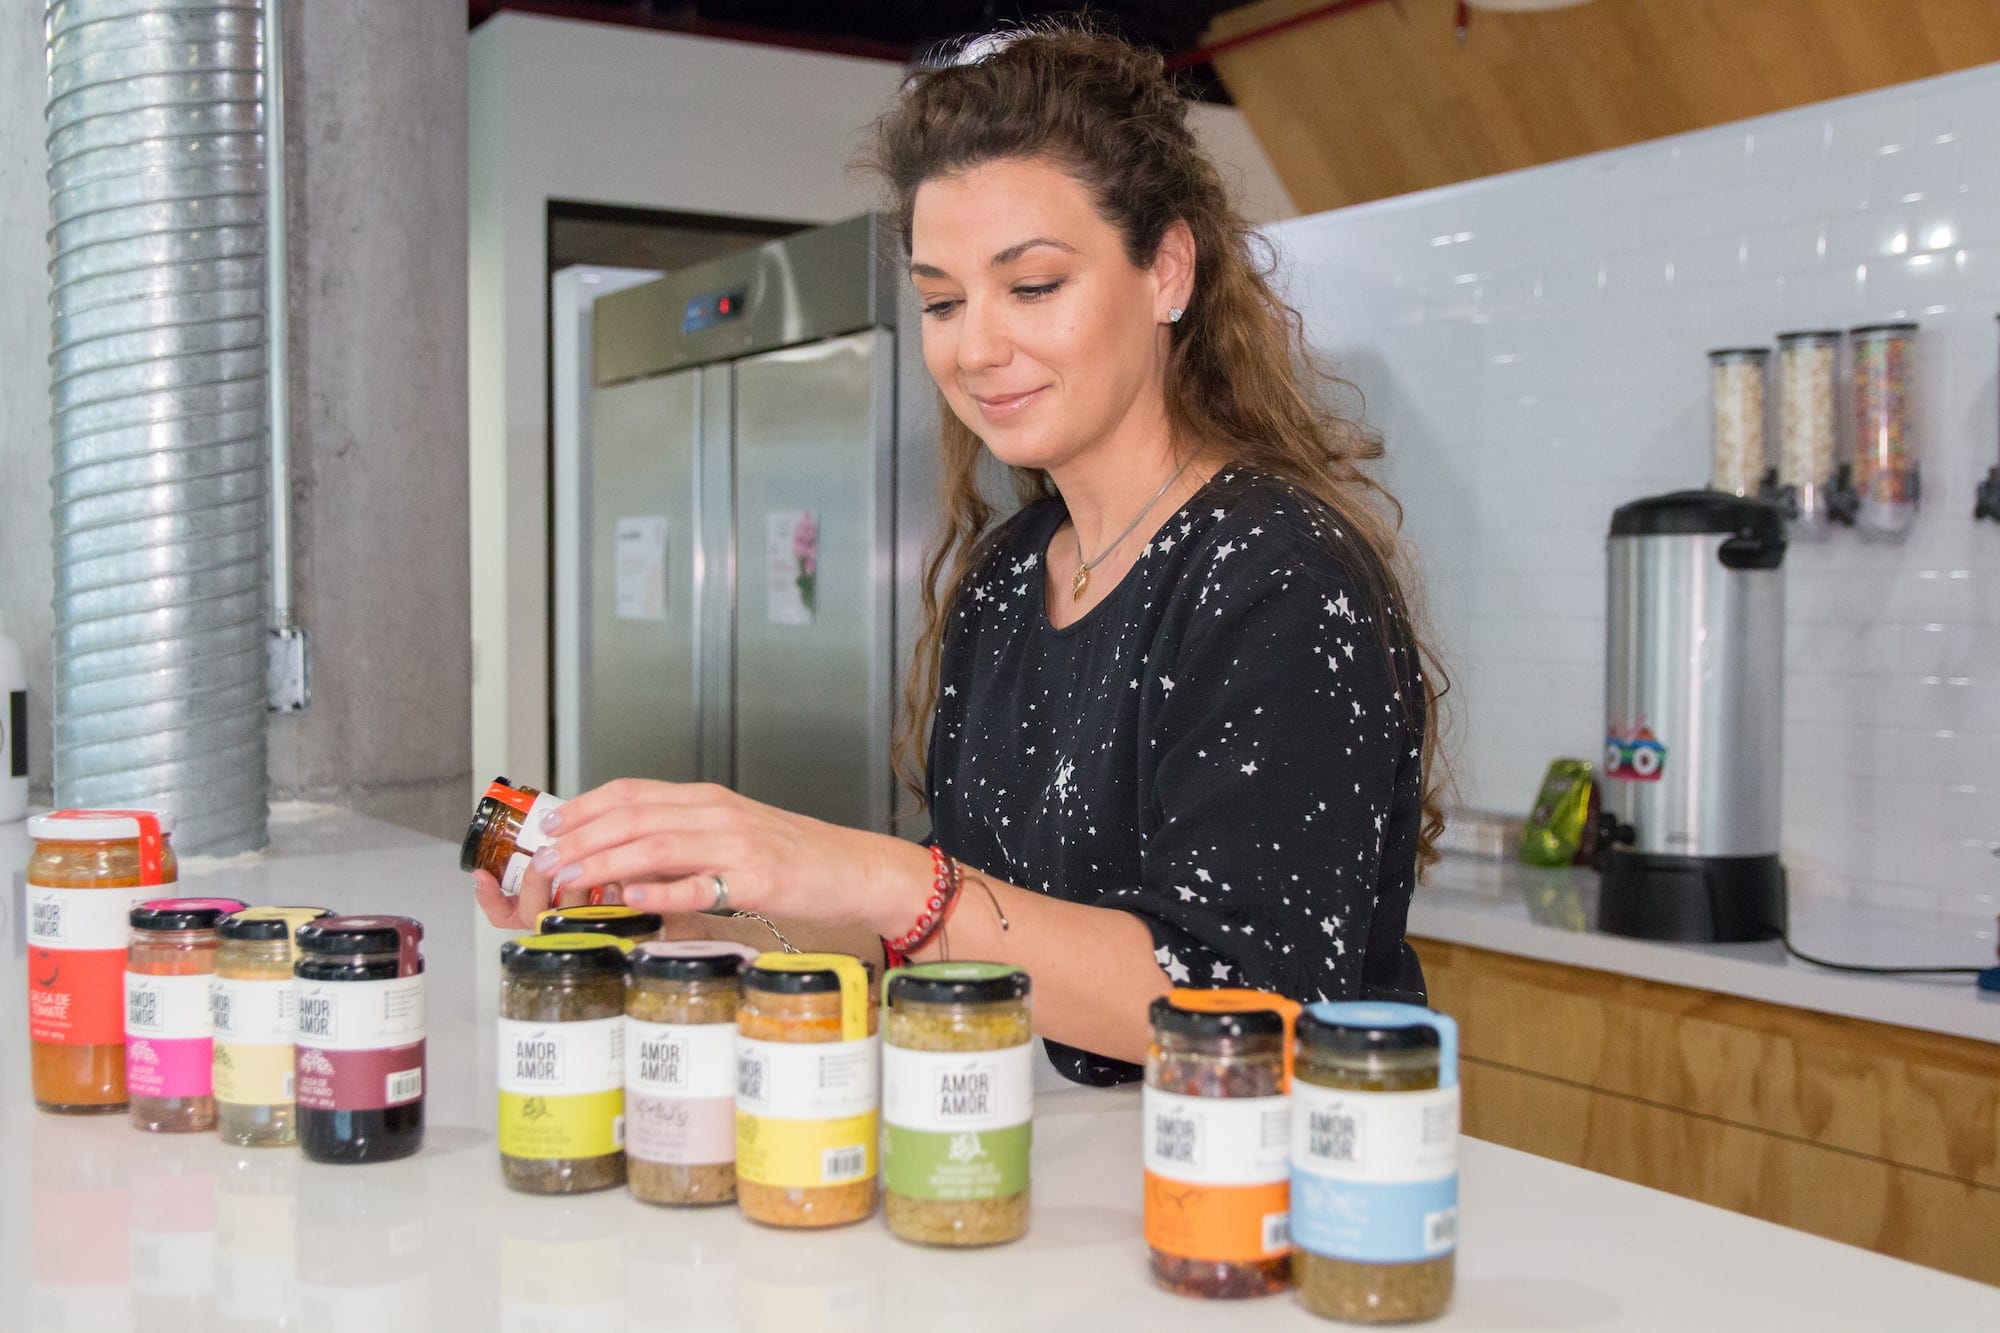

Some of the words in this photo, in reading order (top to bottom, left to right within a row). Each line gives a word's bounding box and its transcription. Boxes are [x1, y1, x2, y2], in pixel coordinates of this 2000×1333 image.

[33, 902, 60, 921] AMOR
[55, 993, 71, 1007] DE
[129, 990, 156, 1009] AMOR
[299, 997, 330, 1018] AMOR
[516, 1040, 557, 1061] AMOR
[640, 1041, 680, 1063] AMOR
[940, 1073, 989, 1094] AMOR
[1155, 1114, 1197, 1140] AMOR
[1309, 1110, 1356, 1138] AMOR
